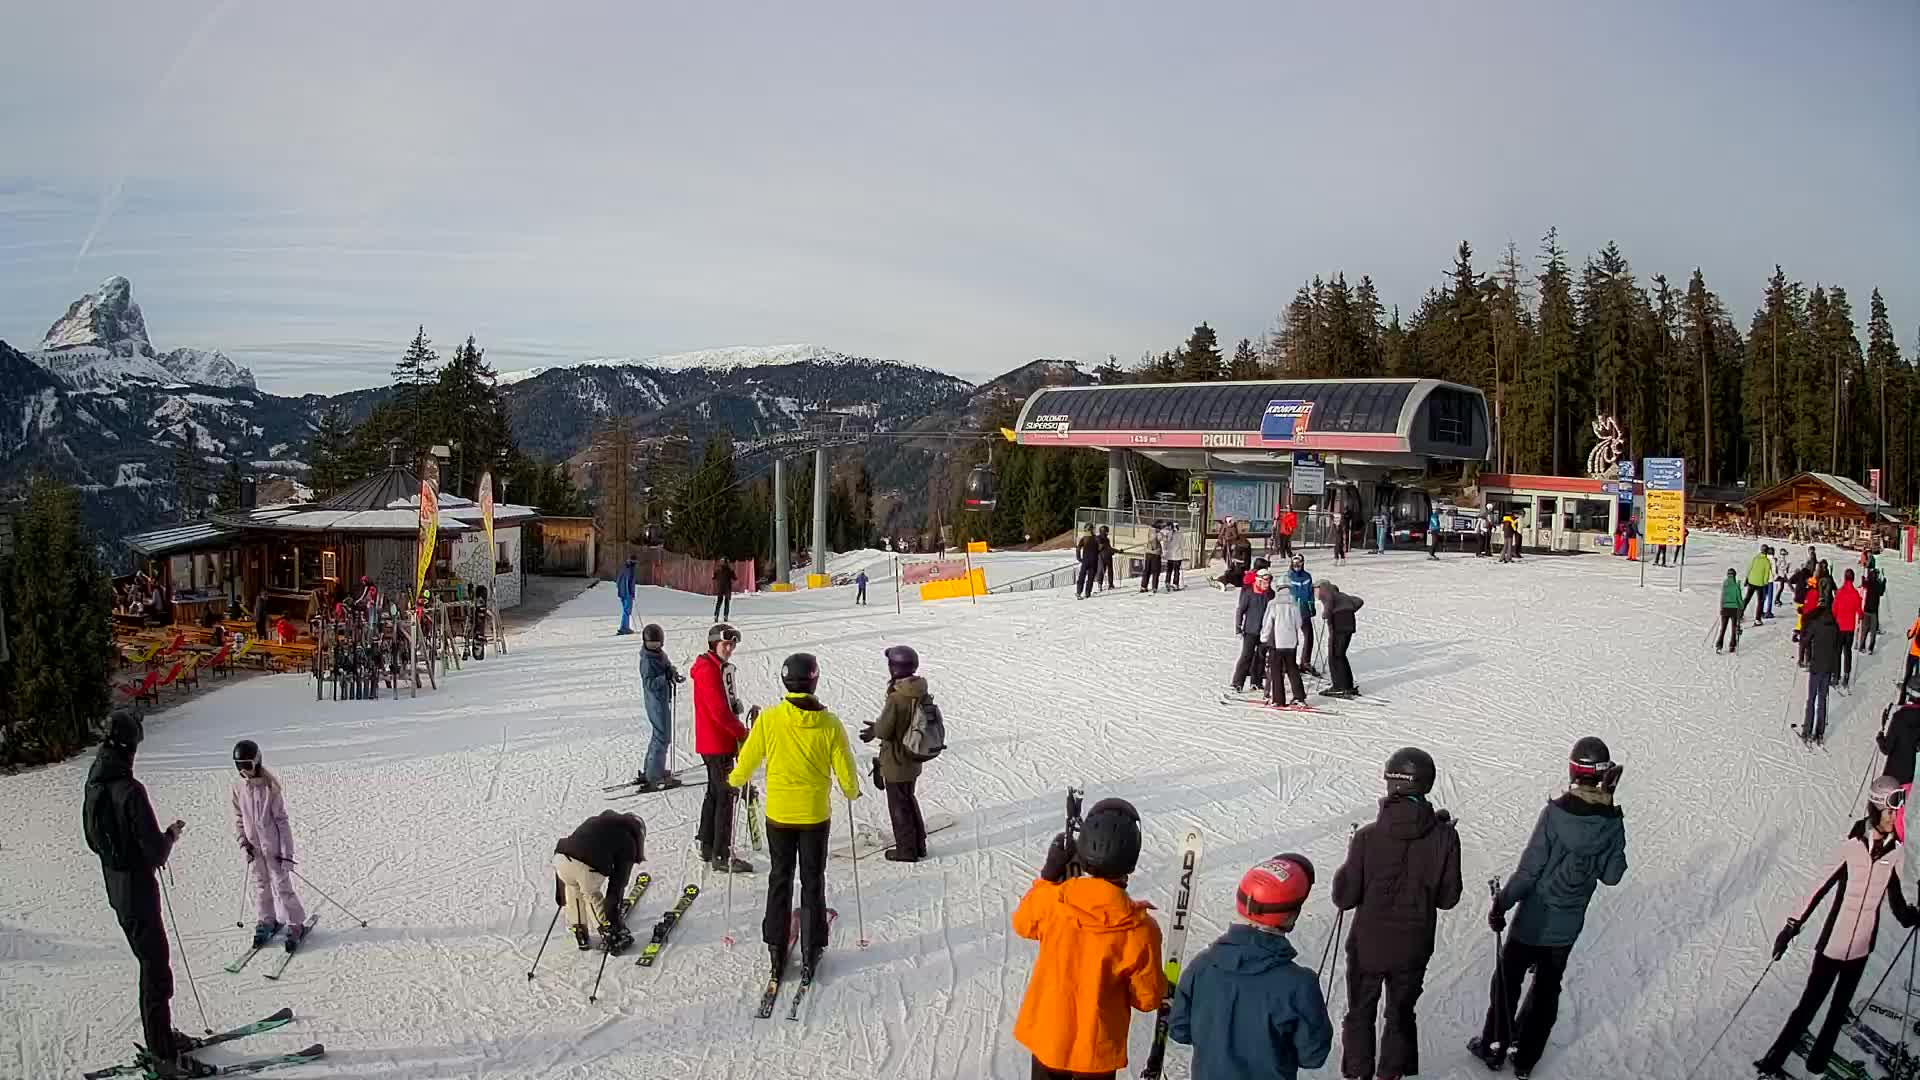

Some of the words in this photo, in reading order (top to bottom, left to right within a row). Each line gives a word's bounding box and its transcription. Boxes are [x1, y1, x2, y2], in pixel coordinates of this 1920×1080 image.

[1202, 434, 1245, 447] PICULIN
[1173, 850, 1195, 930] HEAD
[1869, 1004, 1903, 1021] HEAD
